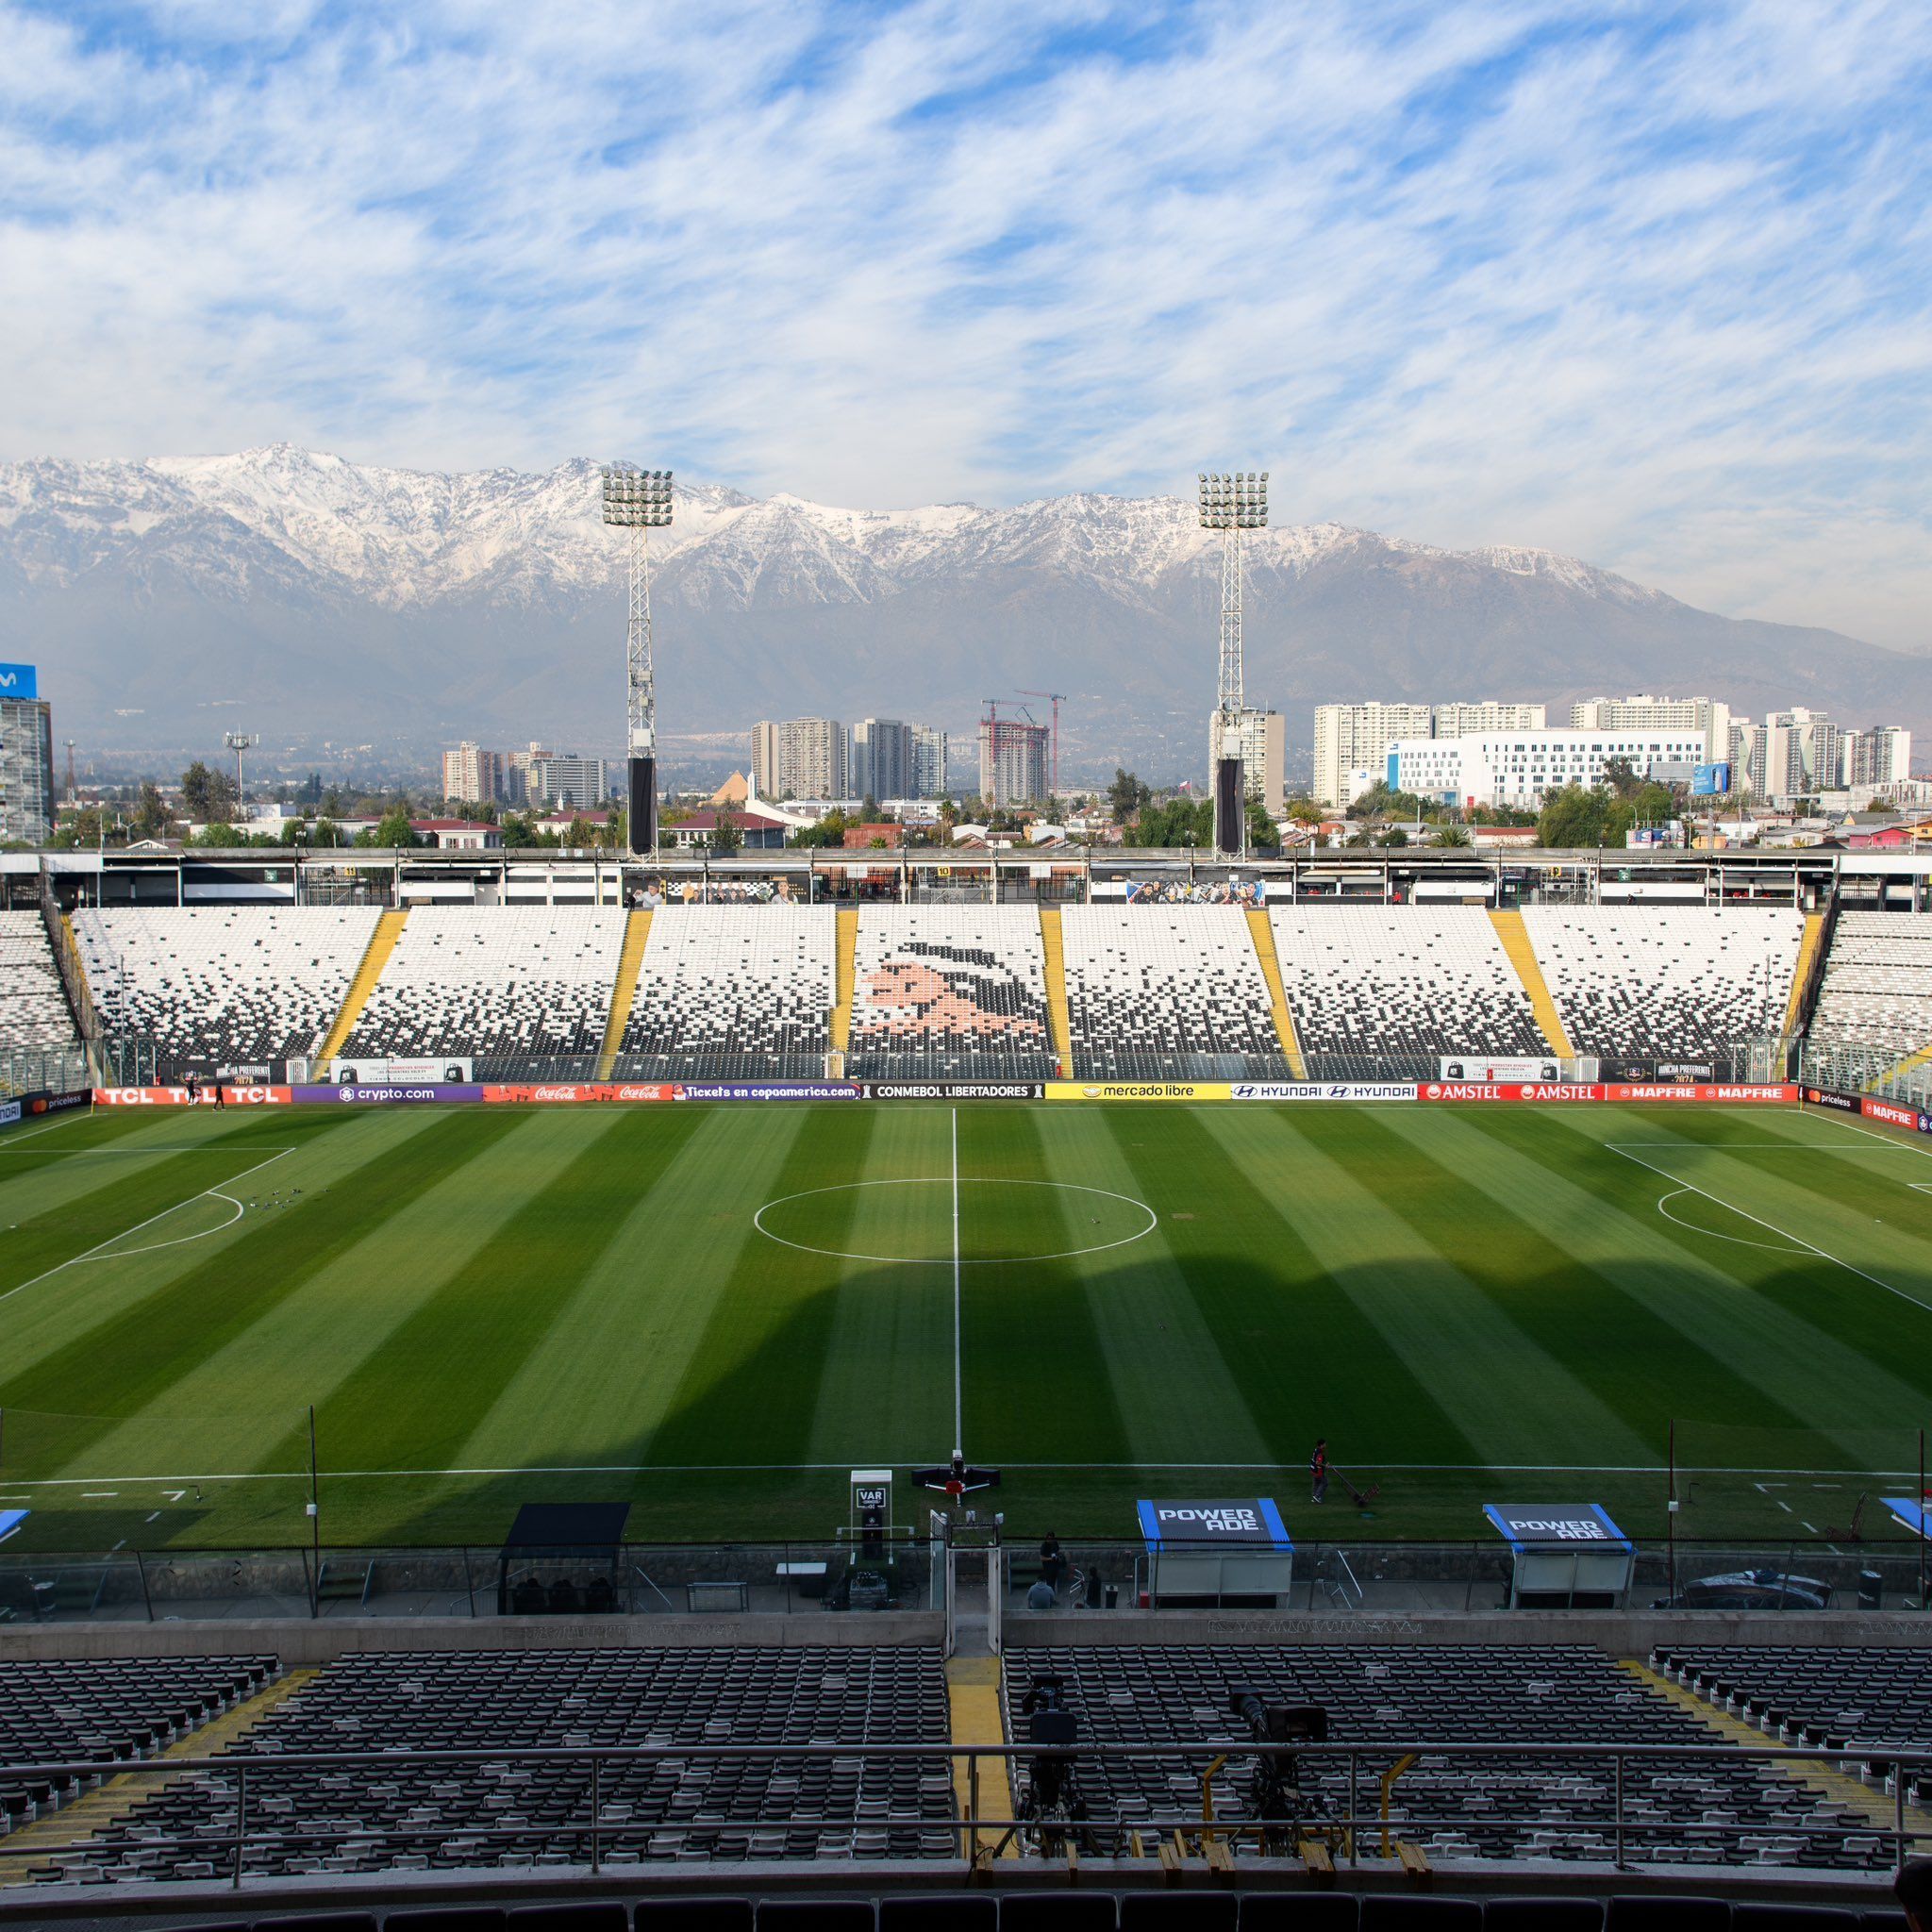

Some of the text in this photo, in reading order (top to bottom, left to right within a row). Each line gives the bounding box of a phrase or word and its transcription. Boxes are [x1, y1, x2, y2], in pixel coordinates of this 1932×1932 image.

[939, 867, 949, 875] 10
[105, 1088, 154, 1104] TCL
[230, 1087, 279, 1103] TCL
[358, 1087, 435, 1102] crypto.com
[535, 1086, 576, 1100] Coca-Cola
[620, 1086, 661, 1099] Coca-Cola
[686, 1086, 856, 1100] Tickets en copaamerica.com
[877, 1085, 1028, 1097] CONMEBOL LIBERTADORES
[1104, 1085, 1194, 1096] mercado libre
[1260, 1087, 1322, 1096] HYUNDAI
[1355, 1087, 1415, 1096] HYUNDAI
[1442, 1085, 1501, 1099] AMSTEL
[1536, 1085, 1595, 1099] AMSTEL
[1631, 1087, 1696, 1098] MAPFRE
[1717, 1087, 1783, 1099] MAPFRE
[48, 1094, 82, 1110] priceless
[1821, 1094, 1851, 1108] priceless
[1873, 1104, 1912, 1125] MAPFRE
[859, 1491, 883, 1500] VAR
[1158, 1508, 1255, 1521] POWER
[1206, 1519, 1260, 1531] ADE
[1509, 1520, 1599, 1531] POWER
[1557, 1529, 1607, 1540] ADE
